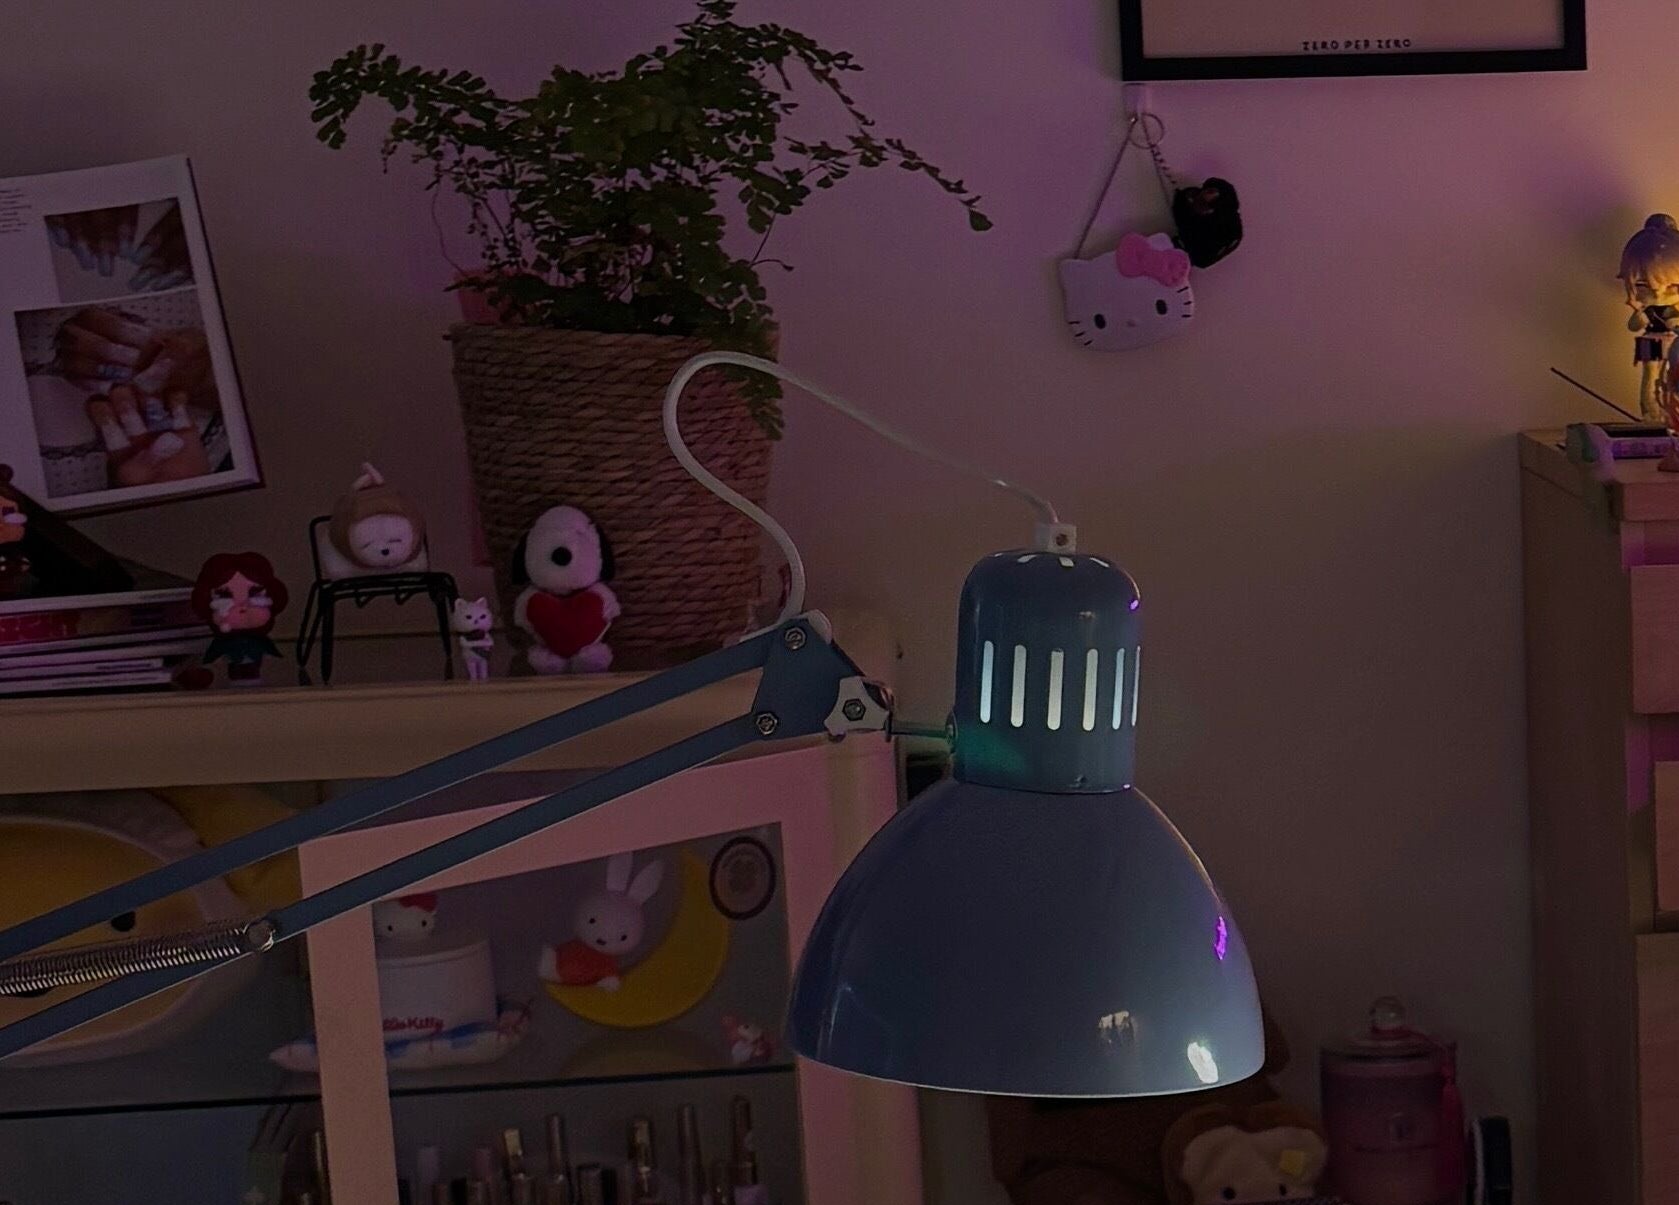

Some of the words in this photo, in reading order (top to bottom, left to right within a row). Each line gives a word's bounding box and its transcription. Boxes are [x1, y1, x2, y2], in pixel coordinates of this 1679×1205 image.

[1303, 40, 1340, 51] ZERO
[1344, 39, 1370, 49] PER
[1377, 39, 1412, 49] ZERO
